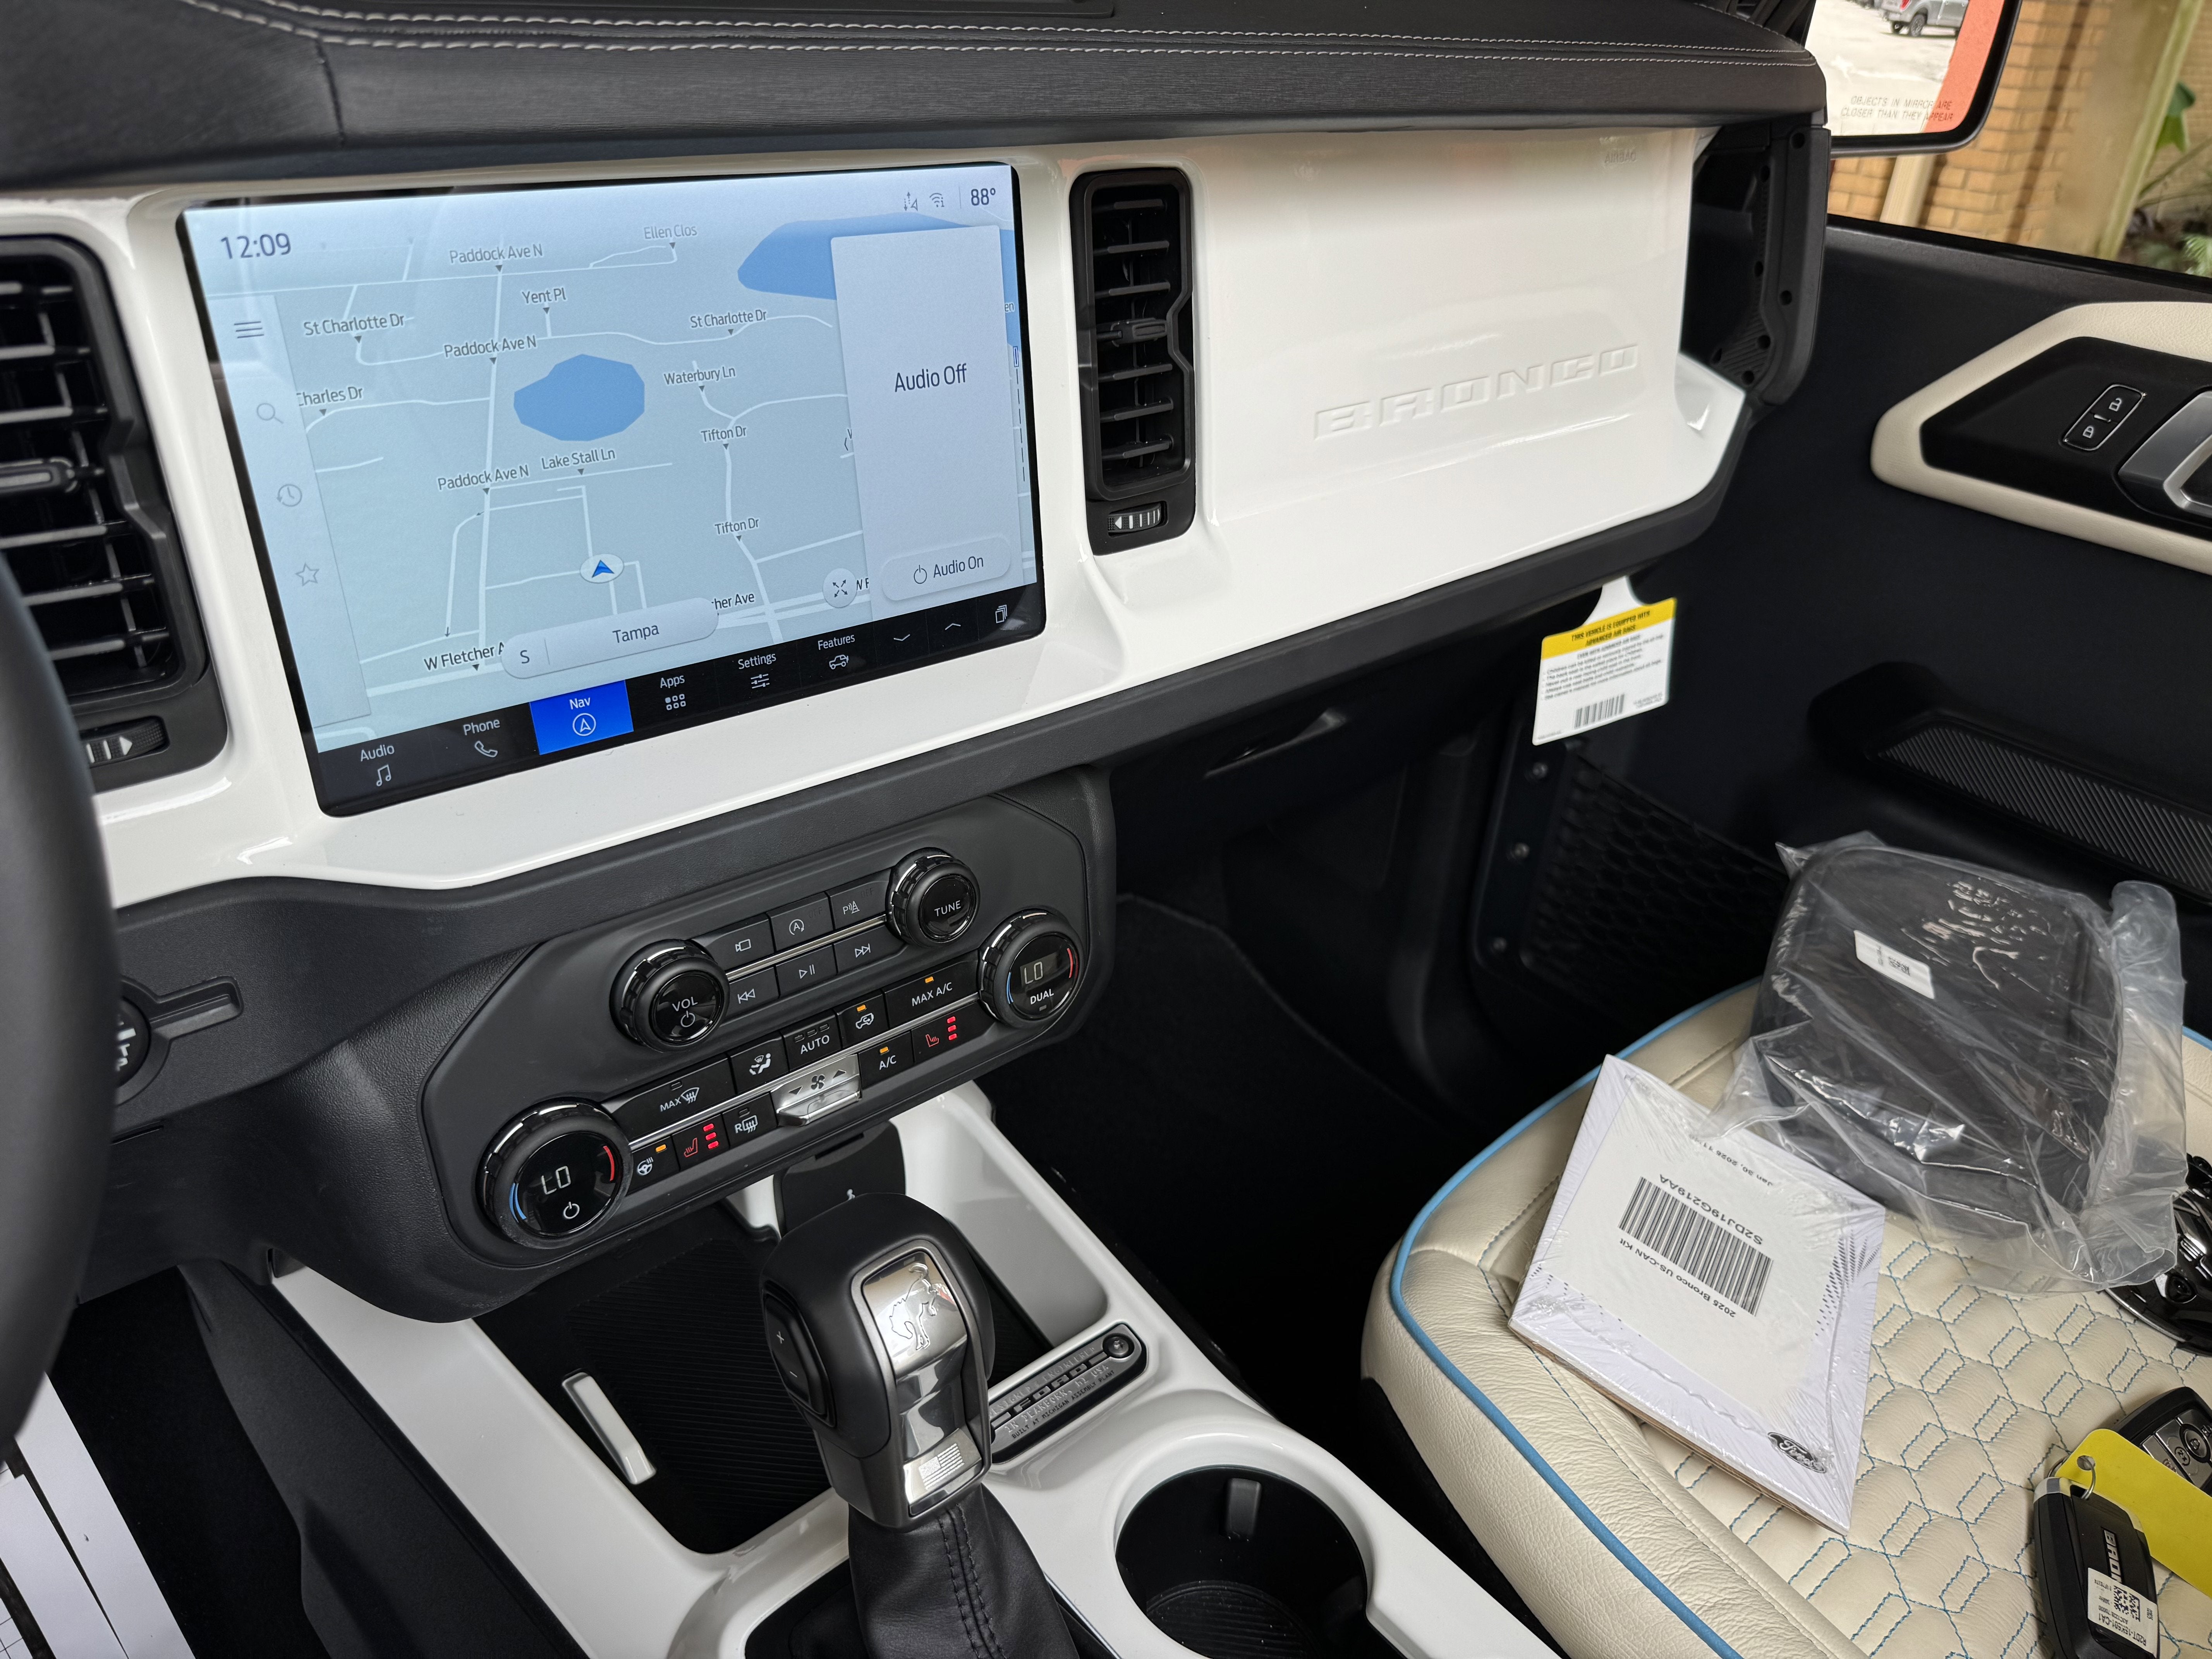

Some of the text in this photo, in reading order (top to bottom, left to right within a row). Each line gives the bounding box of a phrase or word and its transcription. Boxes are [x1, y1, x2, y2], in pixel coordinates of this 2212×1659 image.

[1851, 95, 1953, 111] OBJECTS IN MIRROR ARE
[1841, 107, 1953, 122] CLOSER THAN THEY APPEAR
[644, 225, 697, 239] Ellen Clos
[221, 232, 291, 260] 12:09
[450, 244, 543, 264] Paddock Ave N
[522, 288, 567, 304] Yent Pl
[304, 313, 404, 335] St Charlotte Dr
[690, 310, 766, 328] St Charlotte Dr
[444, 336, 537, 358] Paddock Ave N
[664, 366, 735, 385] Waterbury Ln
[895, 363, 967, 392] Audio Off
[348, 386, 362, 400] Dr
[1314, 343, 1637, 440] BRONCO
[701, 426, 747, 443] Tifton Dr
[542, 448, 615, 470] Lake Stall Ln
[438, 465, 529, 491] Paddock Ave N
[715, 518, 759, 535] Tifton Dr
[934, 555, 983, 579] Audio On
[711, 593, 755, 610] her Ave
[612, 624, 659, 644] Tampa
[818, 634, 855, 650] Features
[424, 656, 437, 671] W
[441, 646, 495, 667] Fletcher
[520, 650, 530, 664] S
[738, 653, 776, 670] Settings
[660, 674, 685, 689] Apps
[570, 697, 590, 709] Nav
[463, 718, 500, 735] Phone
[360, 744, 395, 762] Audio
[935, 900, 962, 917] TUNE
[912, 982, 953, 1006] MAX A/C
[1030, 989, 1054, 1005] DUAL
[672, 996, 698, 1012] VOL
[800, 1035, 830, 1054] AUTO
[879, 1054, 897, 1070] A/C
[660, 1097, 682, 1112] MAX
[735, 1123, 743, 1133] R
[1741, 1164, 1754, 1176] 30,
[1757, 1175, 1773, 1187] Jan
[1660, 1174, 1762, 1245] S2DJ19G219AA
[1620, 1238, 1736, 1317] 2025 Bronco US-CAN Kit
[1013, 1363, 1087, 1413] FORD
[1005, 1420, 1019, 1433] IN
[1090, 1365, 1109, 1377] USA
[1012, 1370, 1115, 1439] BUILT AT MICHIGAN ASSEMBLY PLANT
